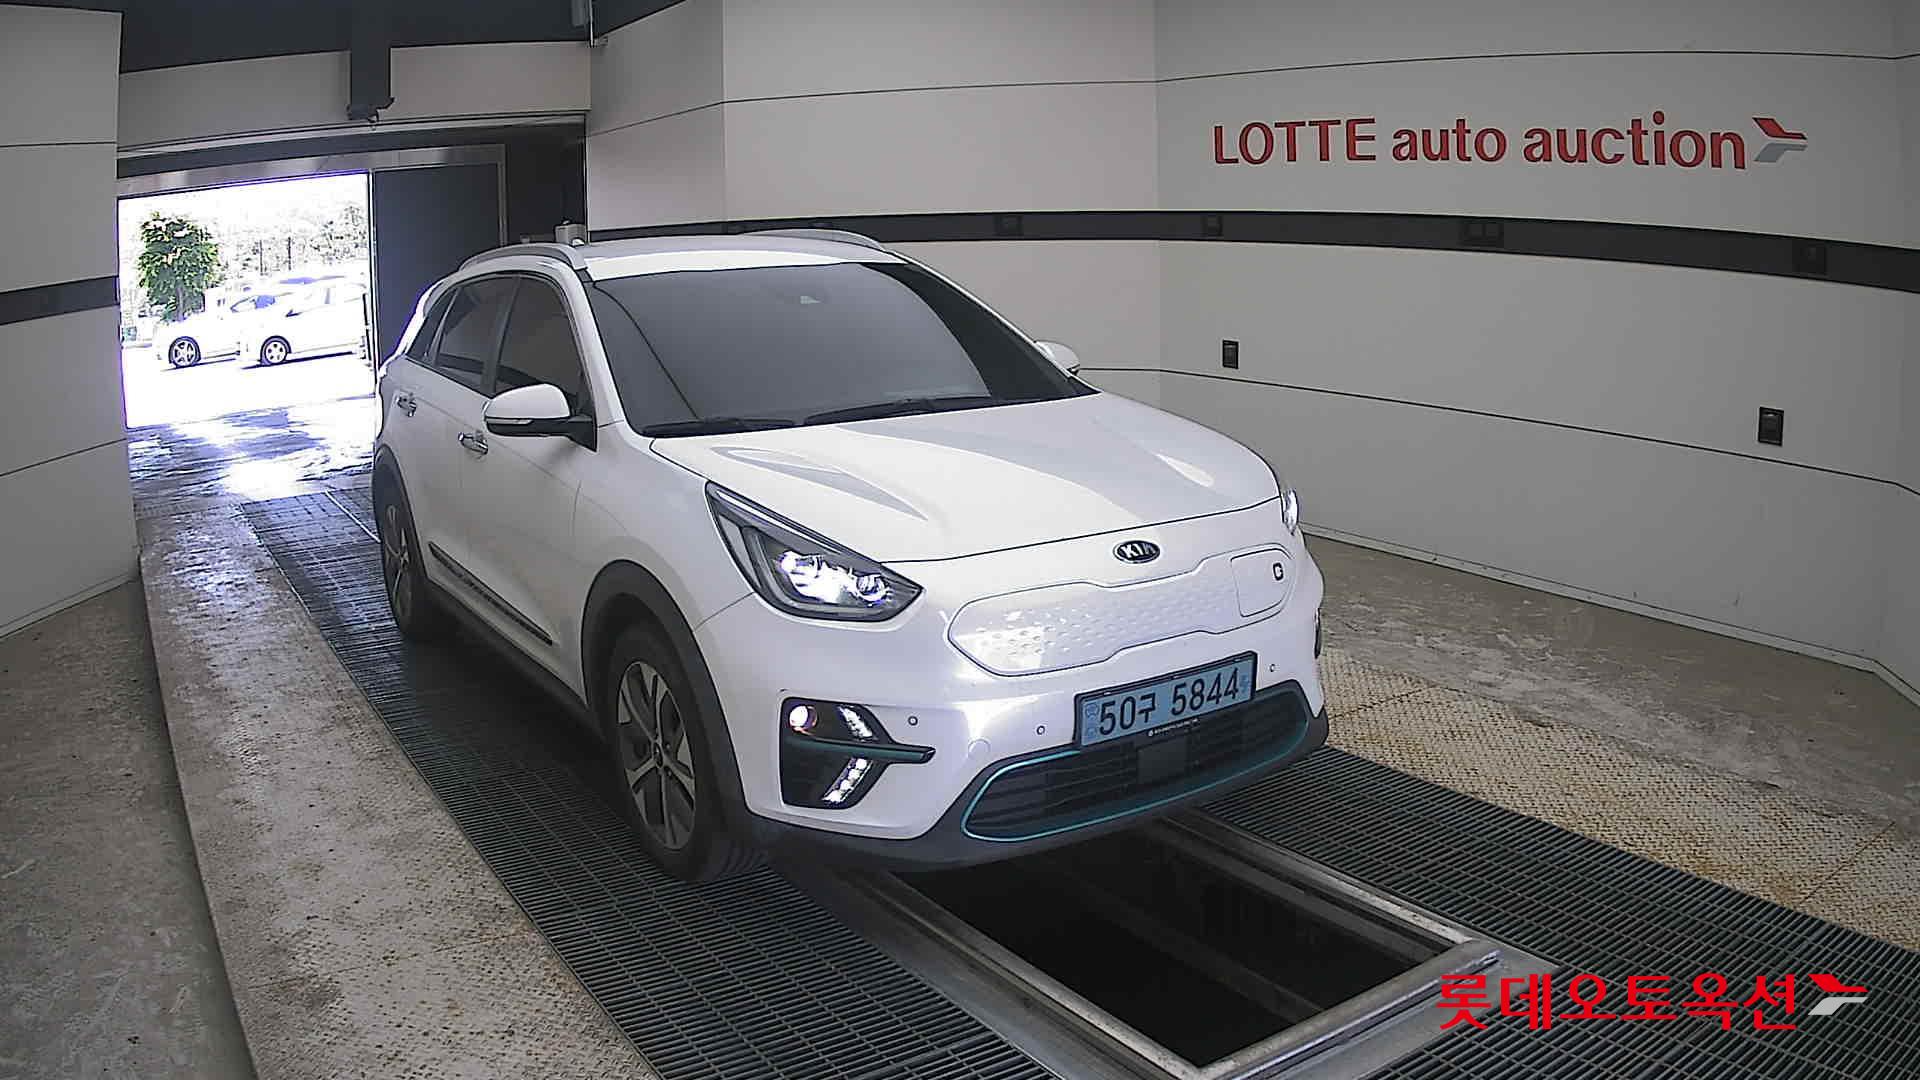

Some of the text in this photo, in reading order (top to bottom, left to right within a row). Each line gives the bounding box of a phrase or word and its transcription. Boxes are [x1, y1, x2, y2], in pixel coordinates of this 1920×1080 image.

[1213, 111, 1747, 170] LOTTE auto auction
[1119, 543, 1157, 560] KIA
[1099, 692, 1156, 736] 50구
[1170, 667, 1240, 716] 5844
